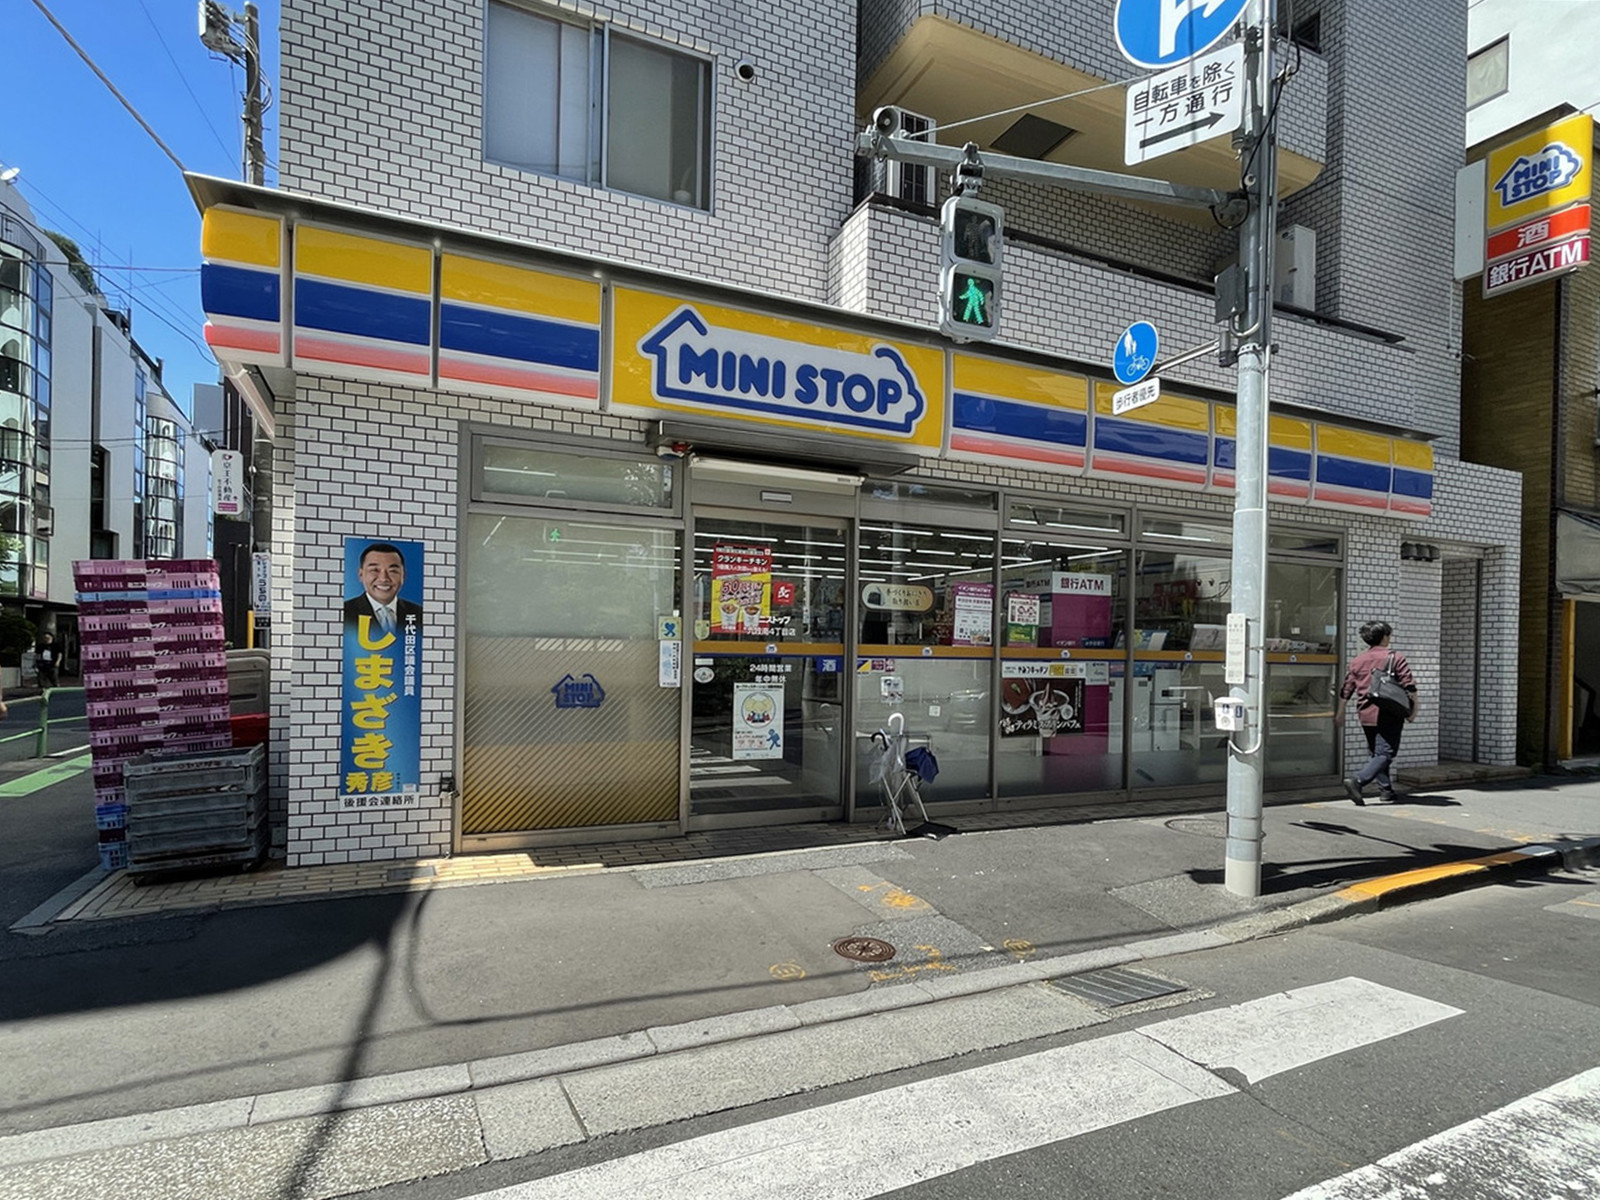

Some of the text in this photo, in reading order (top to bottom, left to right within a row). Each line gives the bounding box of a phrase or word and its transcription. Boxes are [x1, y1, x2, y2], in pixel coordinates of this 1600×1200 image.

[1134, 60, 1236, 111] 自転車を除く
[1134, 82, 1234, 127] 一方通行
[1513, 155, 1560, 184] MINI
[1511, 170, 1562, 198] STOP
[1517, 219, 1550, 248] 酒
[1489, 240, 1583, 288] 銀行ATM
[678, 343, 903, 415] MINI STOP
[1116, 385, 1155, 411] 歩行者優先
[1060, 577, 1104, 591] 銀行ATM
[758, 615, 791, 625] ニストップ
[404, 614, 417, 697] 千代田区議会議員
[750, 663, 792, 673] 24時間営業
[822, 659, 837, 672] 酒
[350, 614, 398, 769] しまざき
[564, 683, 593, 693] MINI
[754, 674, 787, 683] 年中無休
[564, 693, 594, 703] STOP
[345, 771, 393, 793] 秀彦
[344, 794, 414, 808] 後援会連絡所
